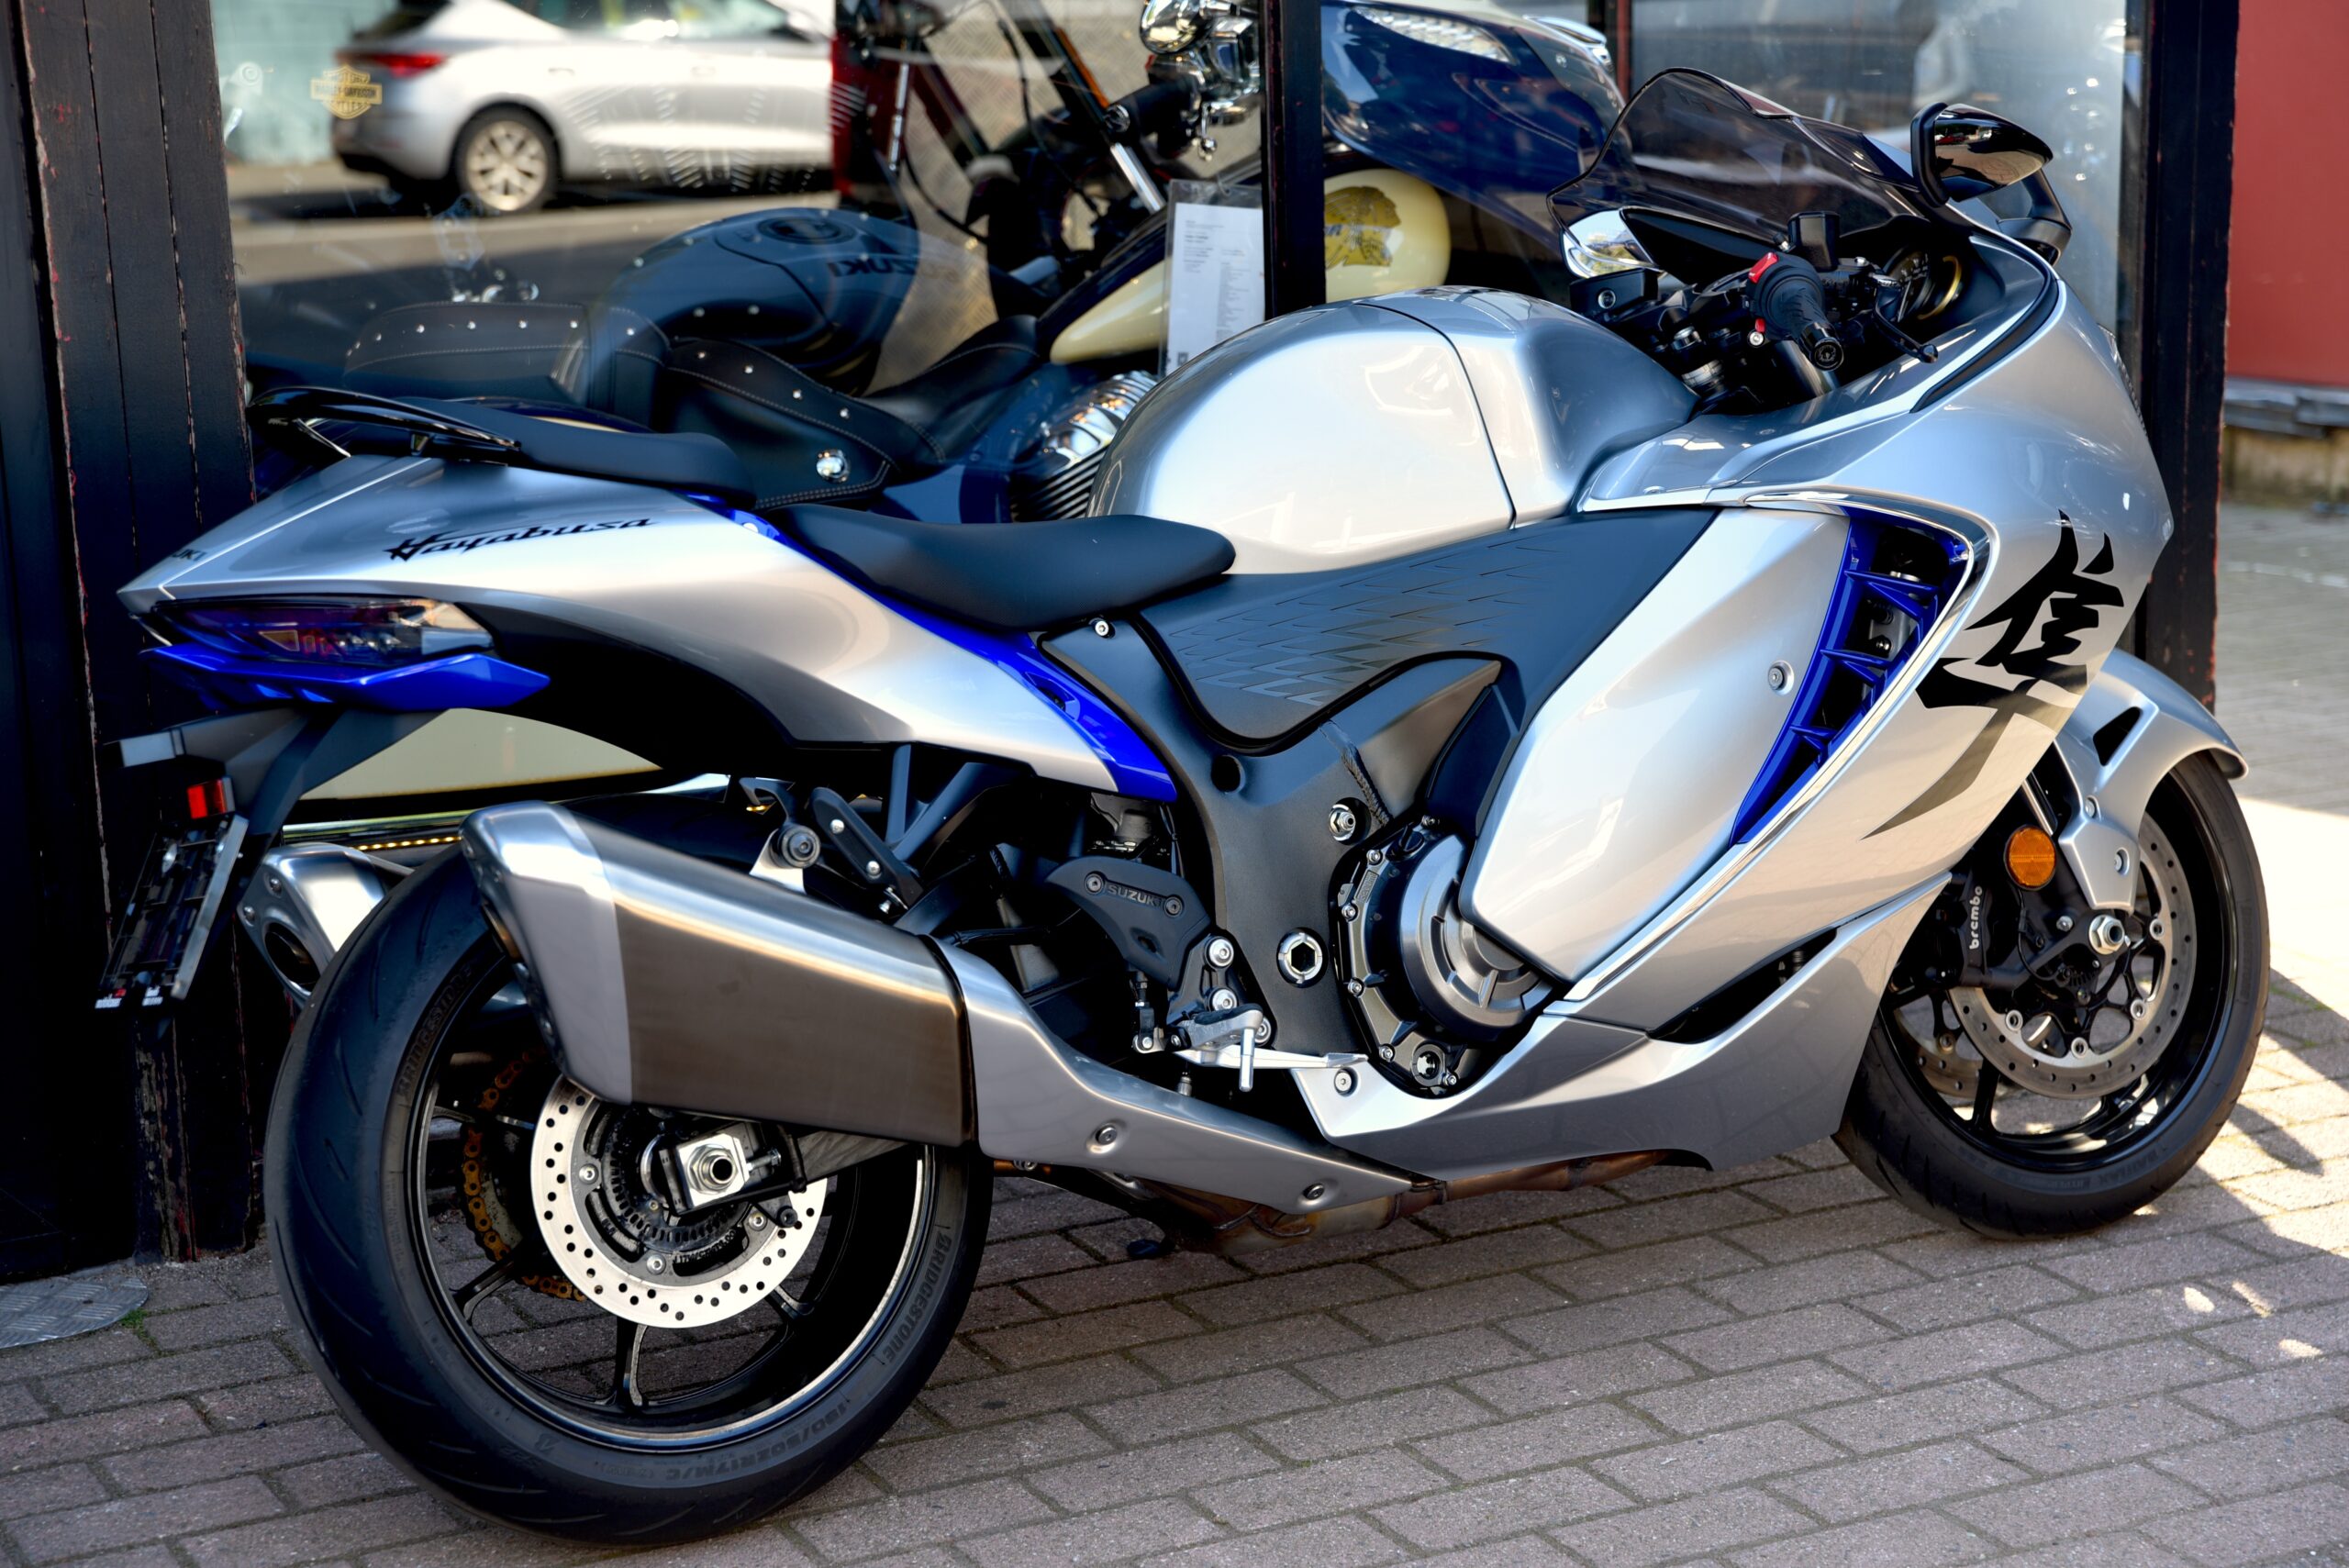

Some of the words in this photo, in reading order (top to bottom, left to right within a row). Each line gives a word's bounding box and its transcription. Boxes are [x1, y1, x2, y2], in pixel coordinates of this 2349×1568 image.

[383, 518, 659, 562] Hayabusa
[1108, 884, 1162, 906] SUZUKI
[1969, 886, 1983, 950] brembo
[883, 1231, 952, 1363] BRIDGESTONE
